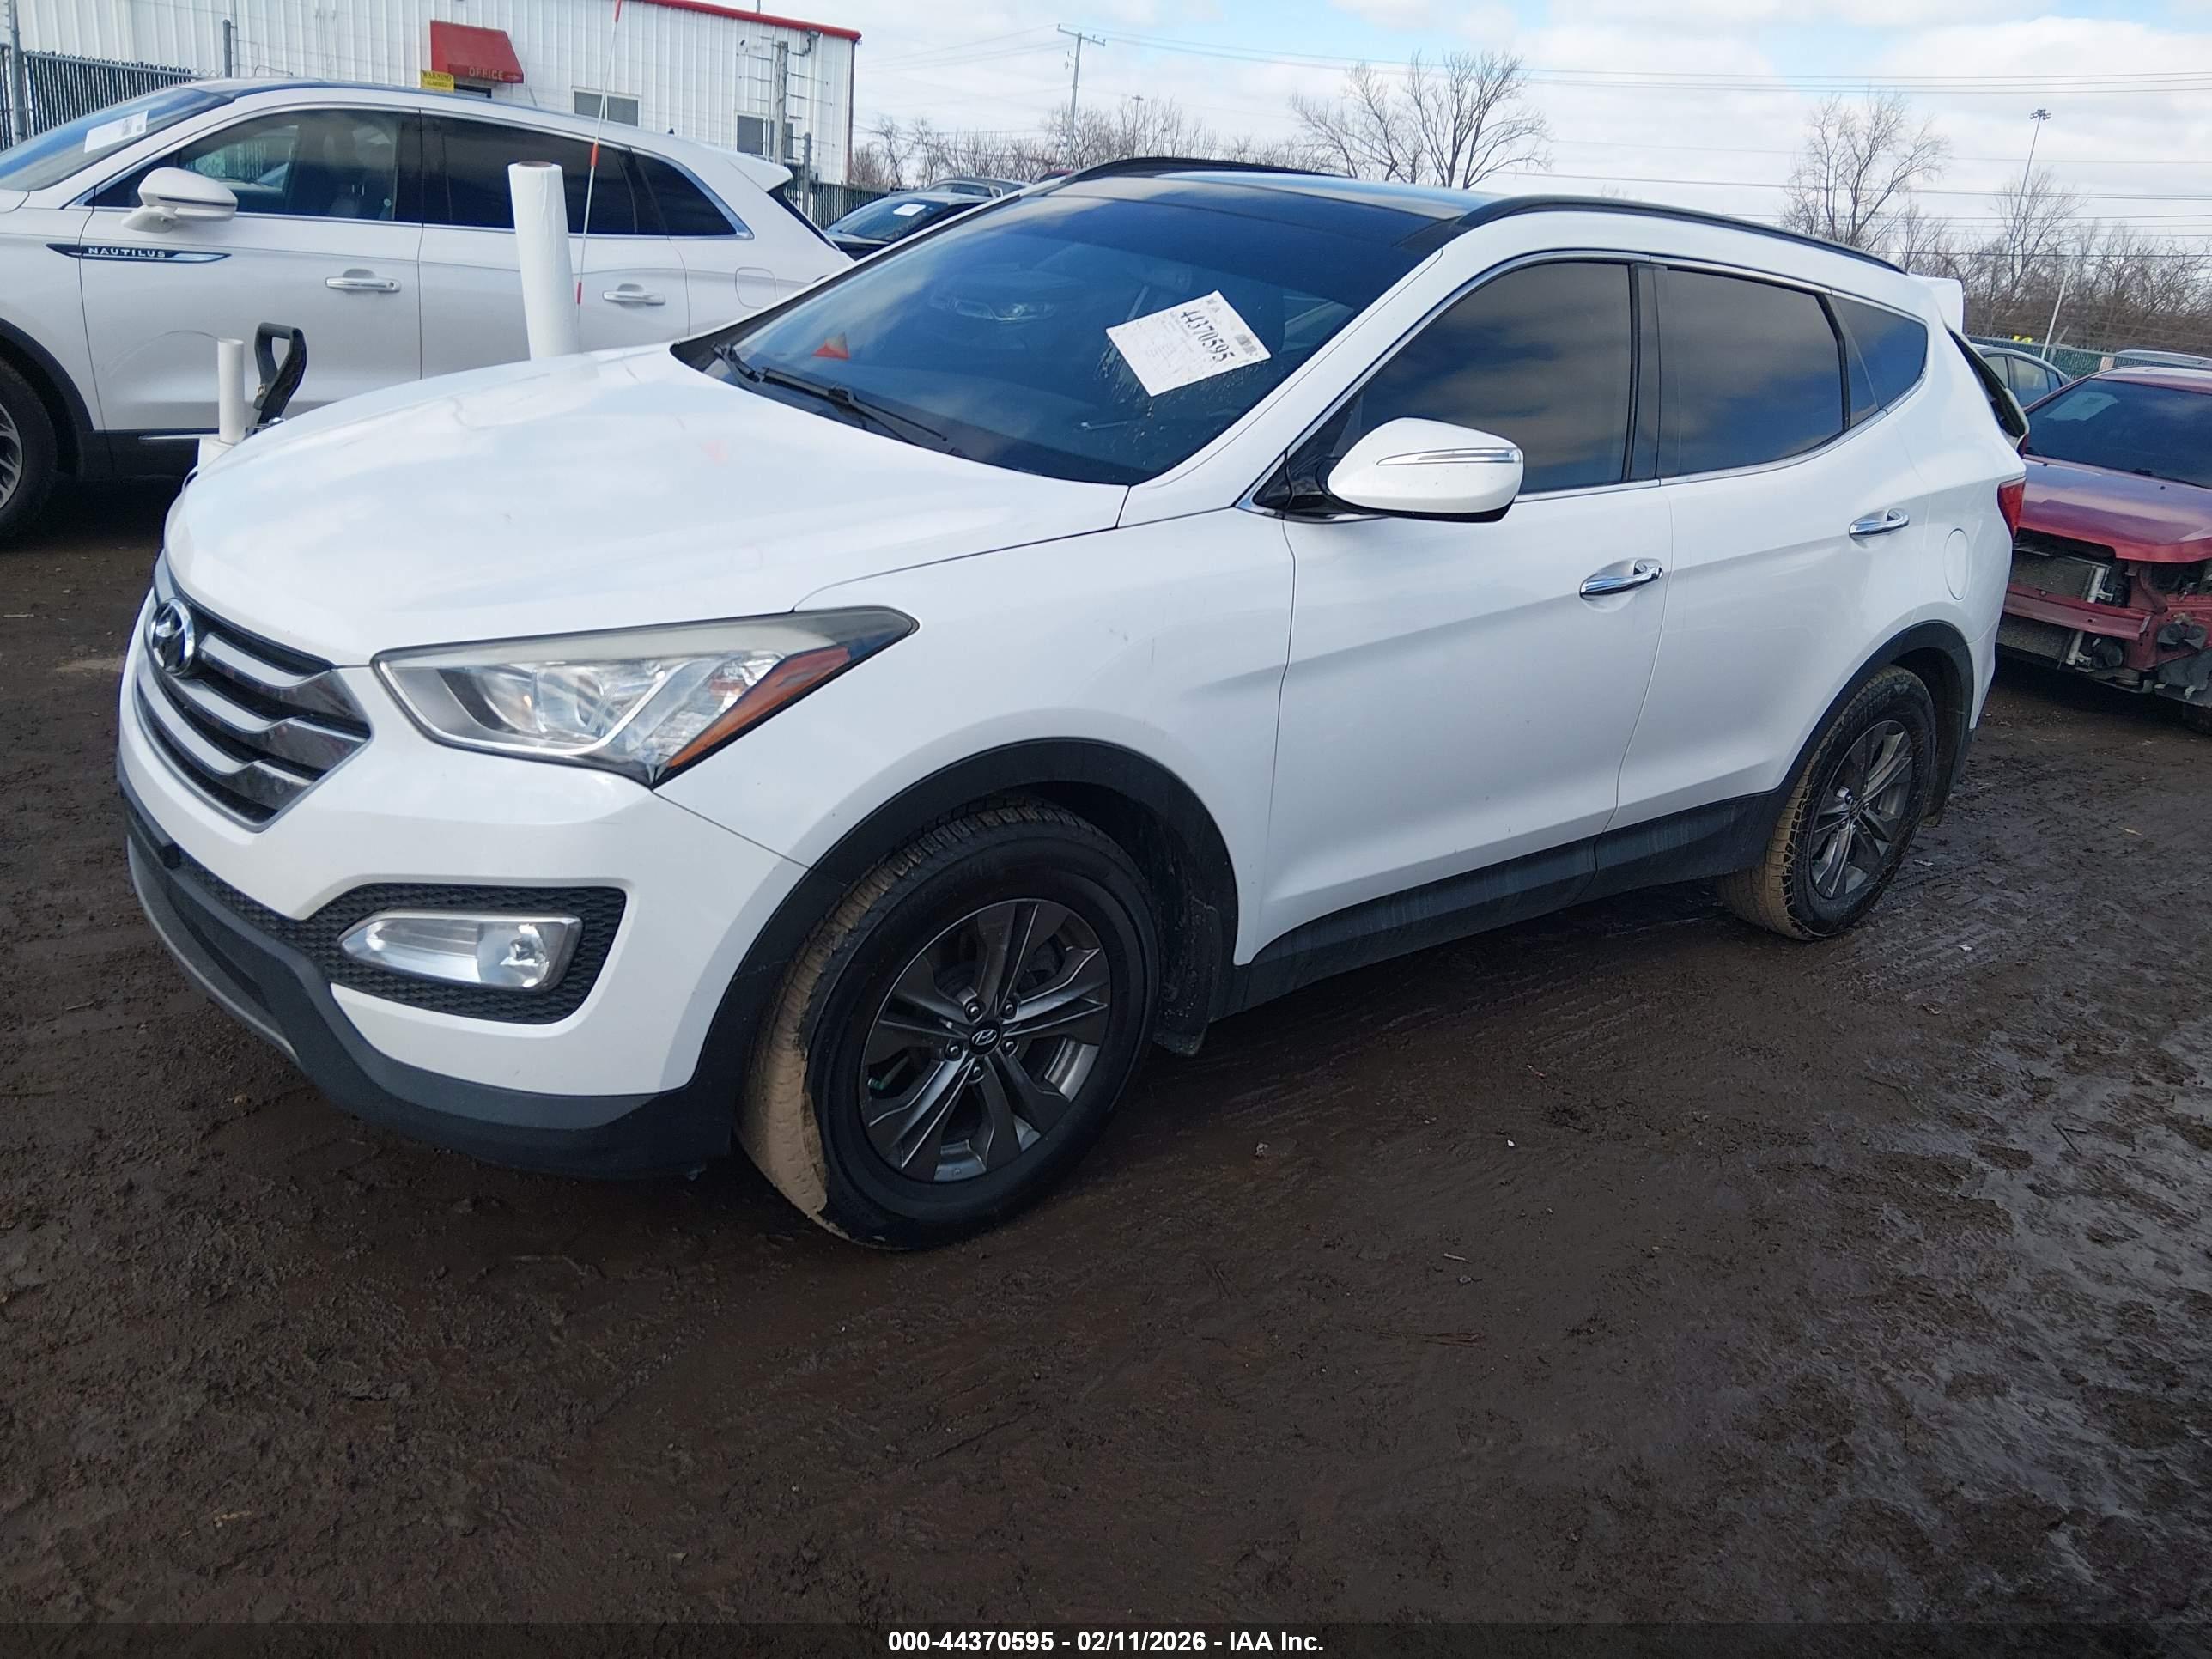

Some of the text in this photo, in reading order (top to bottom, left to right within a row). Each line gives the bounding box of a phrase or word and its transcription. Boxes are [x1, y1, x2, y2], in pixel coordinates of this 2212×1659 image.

[469, 67, 504, 81] OFFICE
[88, 246, 166, 258] NAUTILUS
[1180, 310, 1236, 363] 44370595
